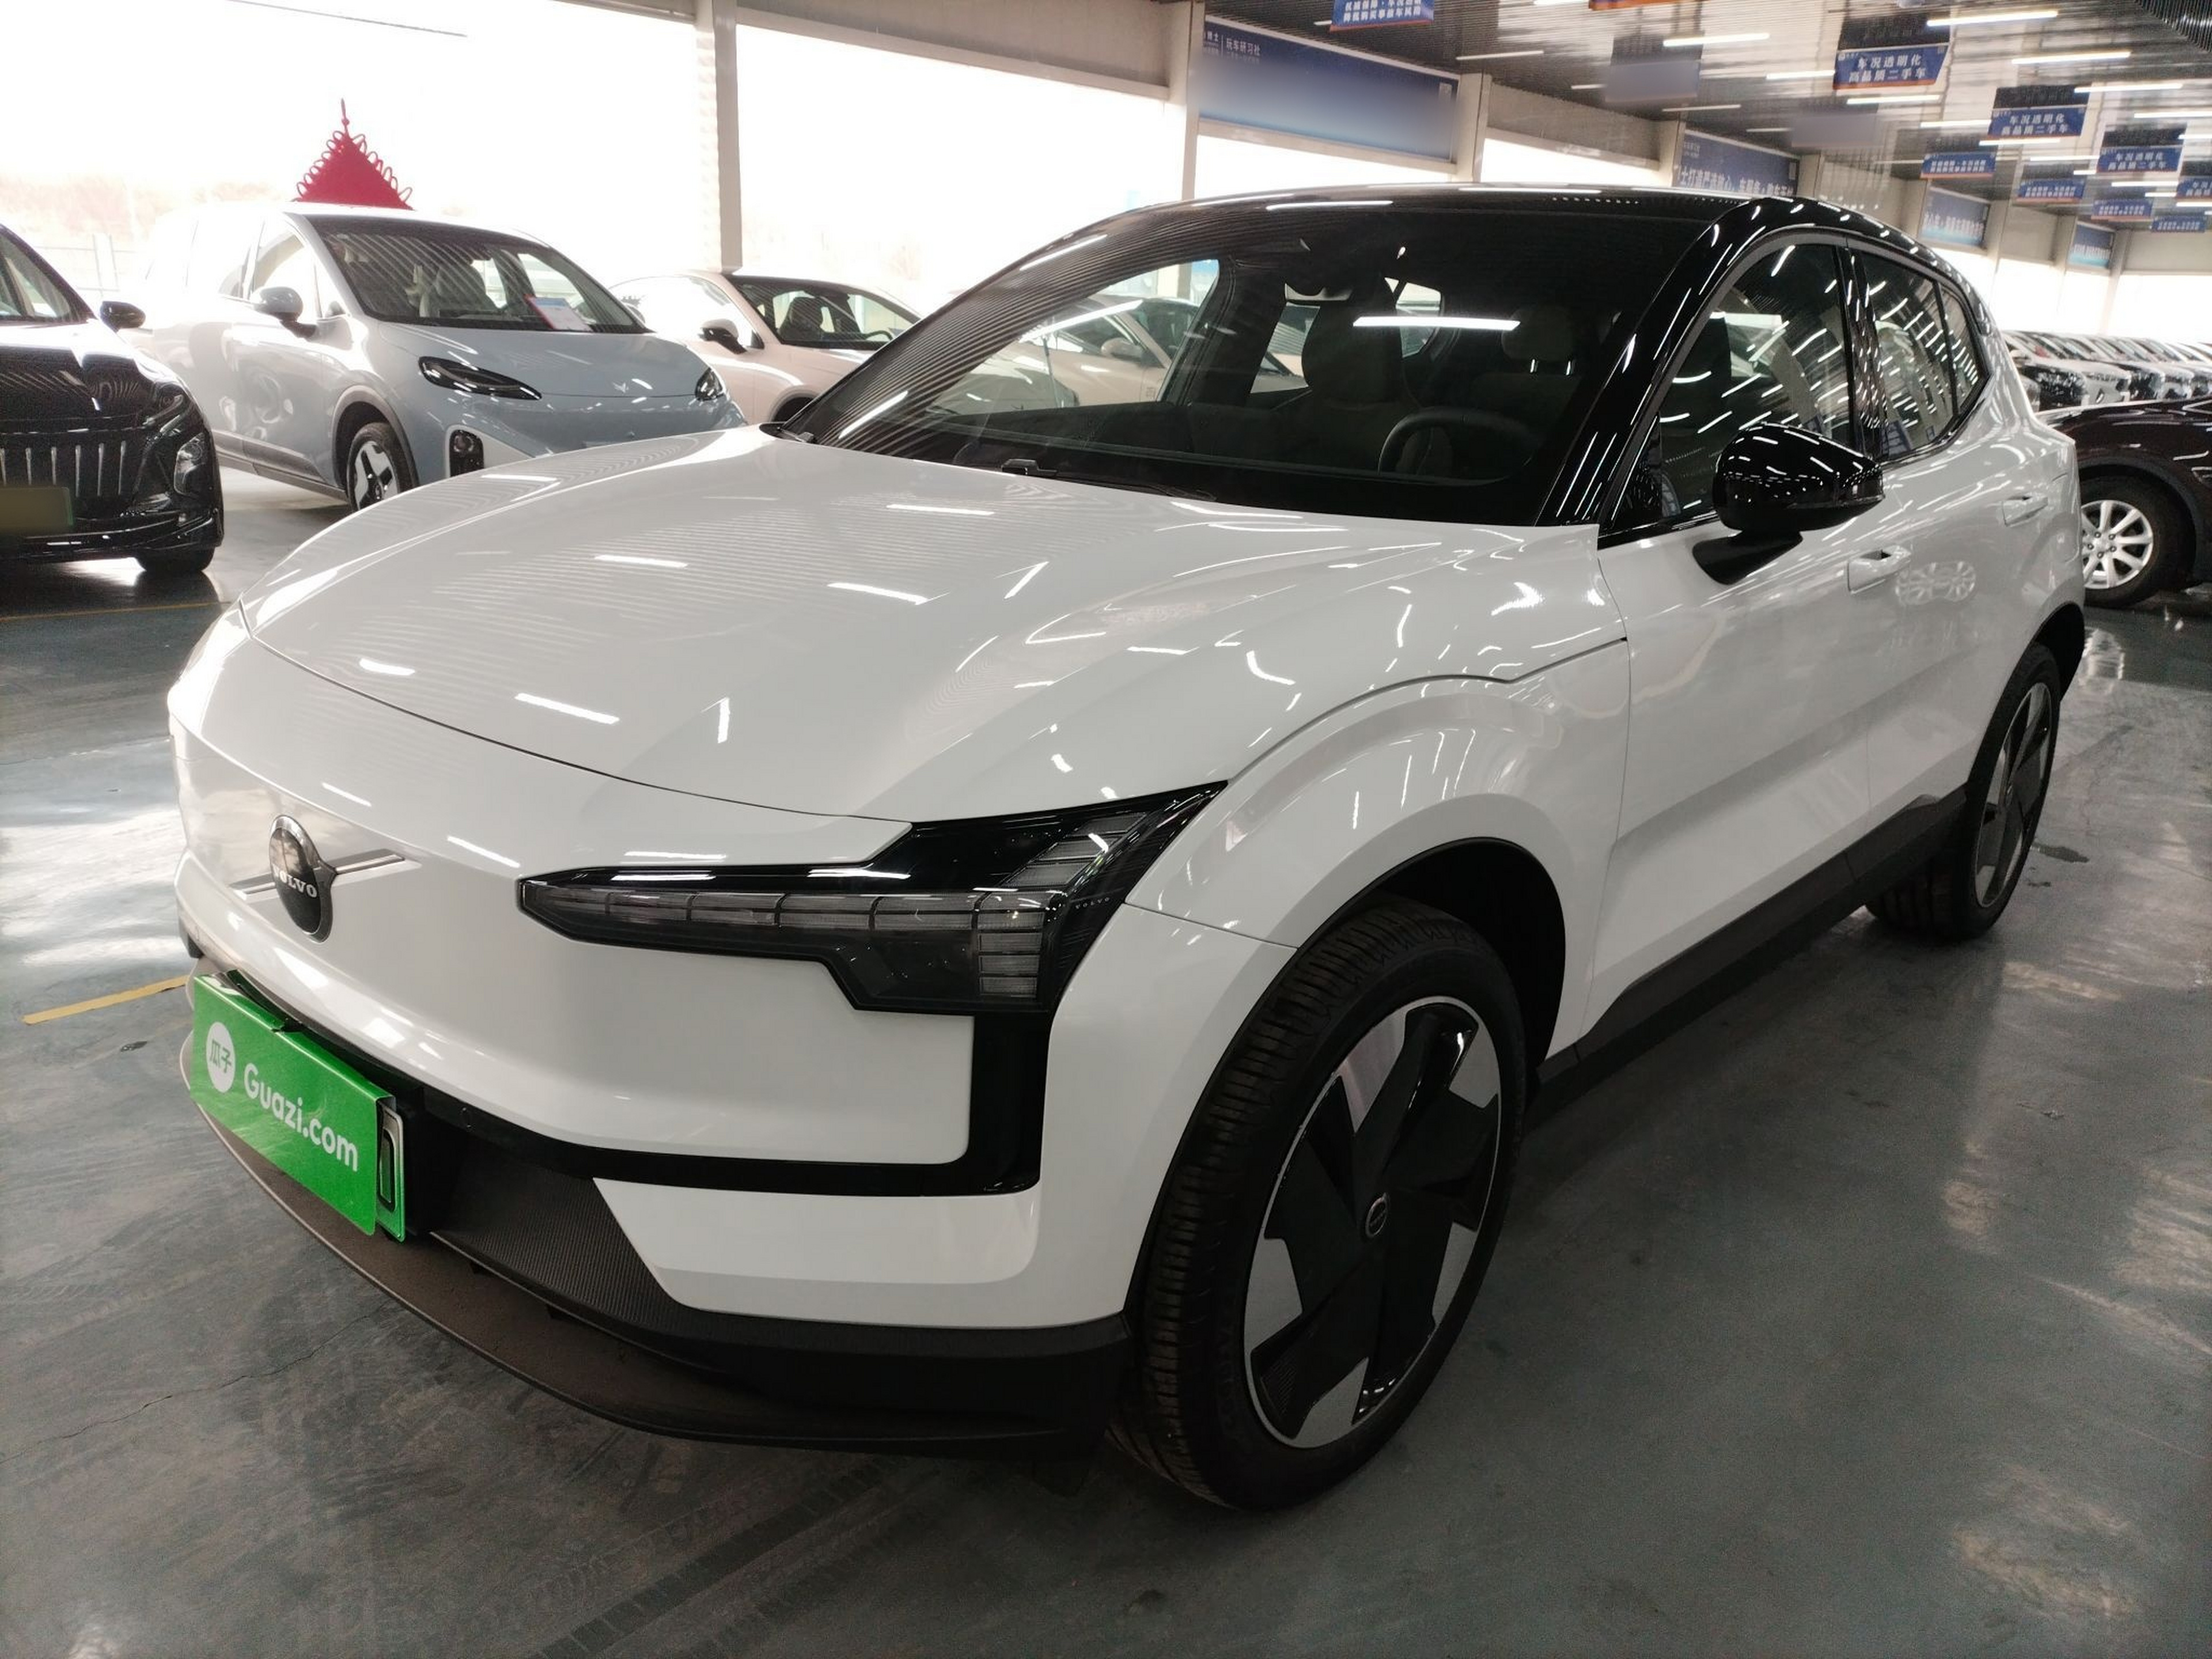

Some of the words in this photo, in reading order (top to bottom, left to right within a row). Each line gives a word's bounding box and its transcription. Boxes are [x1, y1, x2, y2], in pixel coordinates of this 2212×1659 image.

[1858, 54, 1922, 69] 车况透明化
[1849, 67, 1926, 83] 高品质二手车
[272, 864, 317, 897] VOLVO
[244, 1063, 358, 1172] Guazi.com
